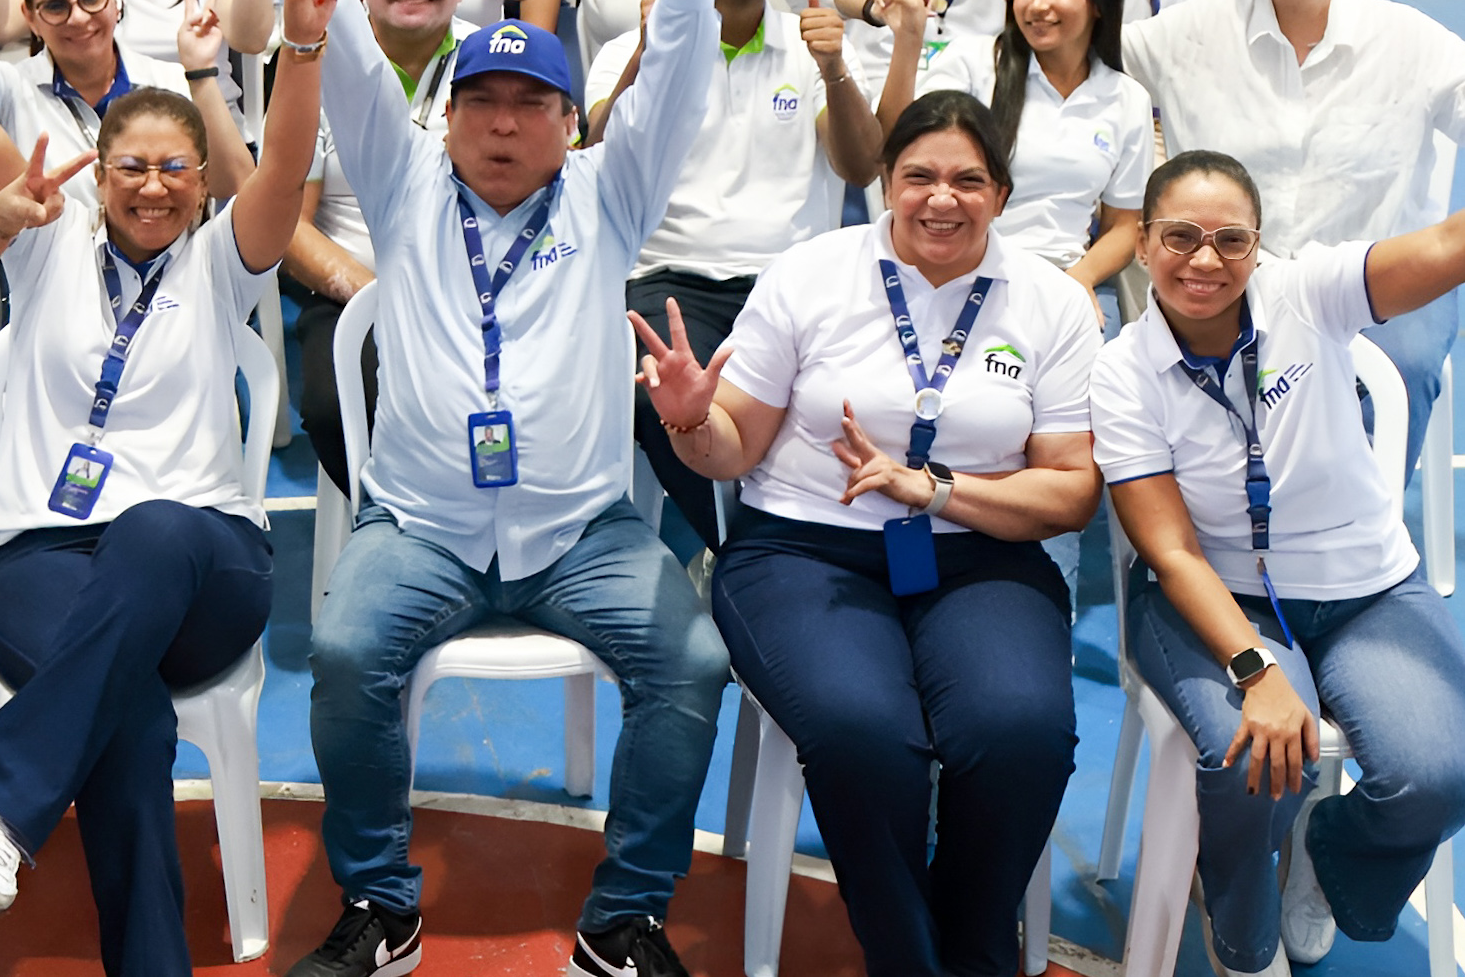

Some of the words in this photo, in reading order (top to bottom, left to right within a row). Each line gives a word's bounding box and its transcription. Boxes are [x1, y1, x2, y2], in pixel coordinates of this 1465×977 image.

[488, 35, 526, 54] fna
[773, 93, 798, 111] fna
[529, 244, 559, 272] fna
[985, 352, 1022, 380] fna
[1257, 375, 1291, 410] fna
